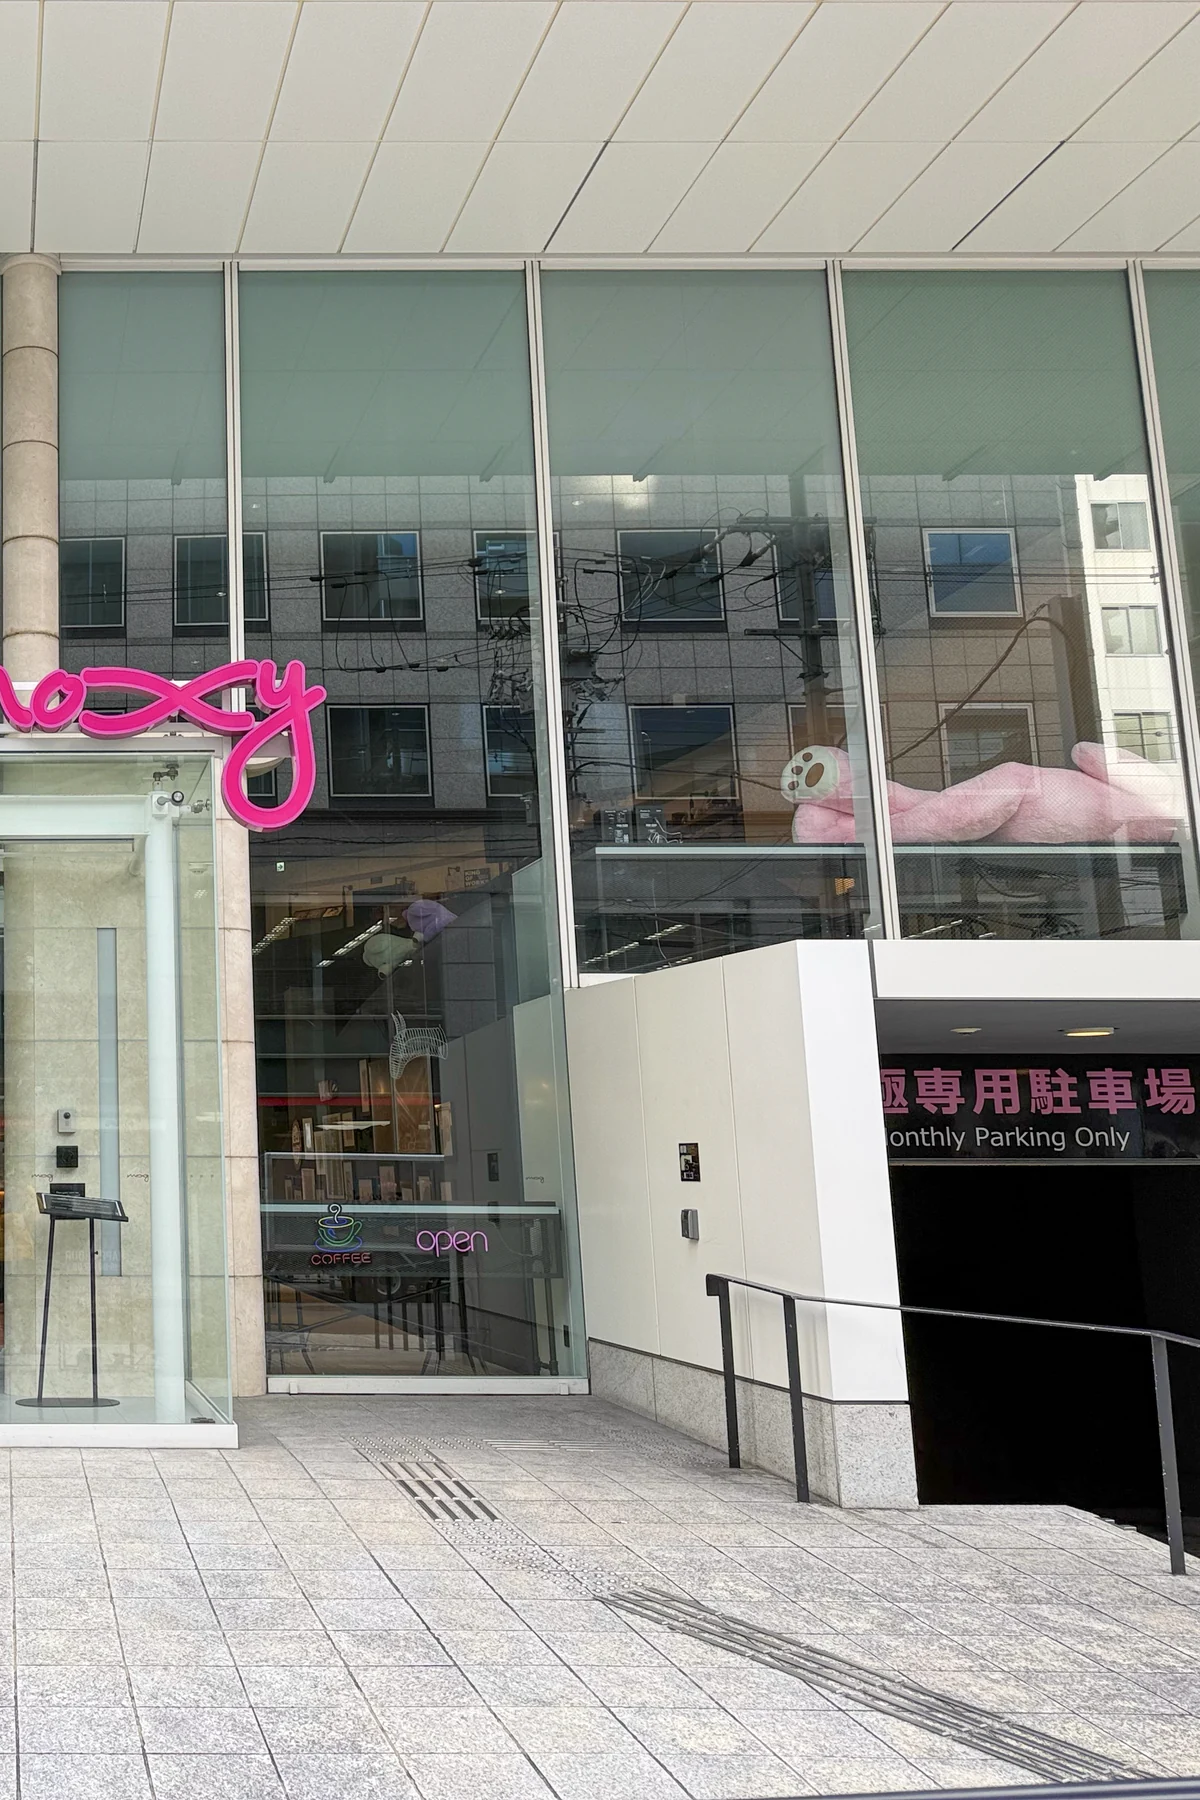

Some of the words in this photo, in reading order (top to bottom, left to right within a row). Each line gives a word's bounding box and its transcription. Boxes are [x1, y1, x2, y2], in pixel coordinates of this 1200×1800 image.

[886, 1126, 966, 1151] onthly
[975, 1127, 1066, 1152] Parking
[1075, 1126, 1131, 1151] Only
[416, 1229, 489, 1258] open
[310, 1252, 371, 1265] COFFEE
